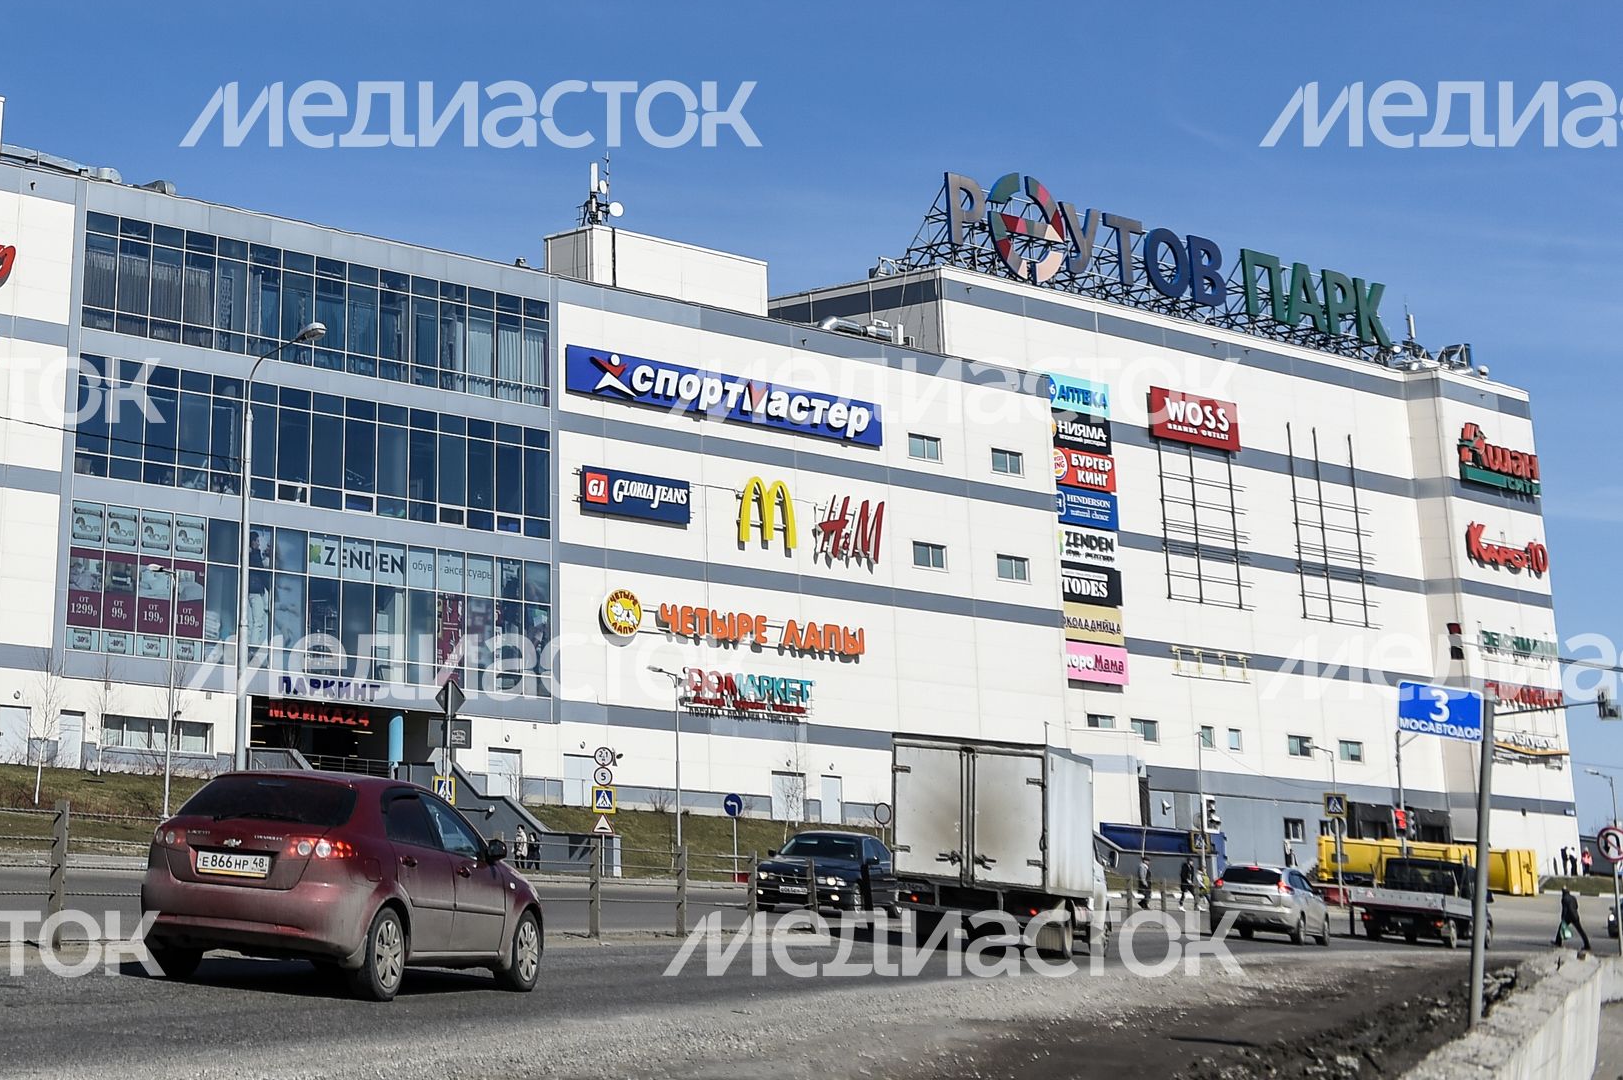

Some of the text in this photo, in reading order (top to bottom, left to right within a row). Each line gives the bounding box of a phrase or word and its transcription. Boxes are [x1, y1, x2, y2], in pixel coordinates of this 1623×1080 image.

[1240, 248, 1391, 348] ПАРК
[1057, 385, 1108, 409] АПТЕКА
[1164, 397, 1230, 432] WOSS
[1070, 453, 1113, 472] БУРГЕР
[1076, 469, 1108, 487] КИНГ
[1067, 494, 1111, 508] HENDERSON
[818, 494, 885, 564] H&M
[1065, 531, 1115, 552] ZENDEN
[324, 546, 406, 575] ZENDEN
[412, 560, 434, 573] обув
[1062, 577, 1109, 598] TODES
[659, 603, 866, 656] ЧЕТЫРЕ ЛАПЫ
[279, 676, 381, 703] ПАРКИНГ
[1429, 689, 1451, 722] 3
[1399, 717, 1482, 739] МОСАВТОДОР
[600, 772, 607, 781] 5
[252, 858, 265, 868] 48
